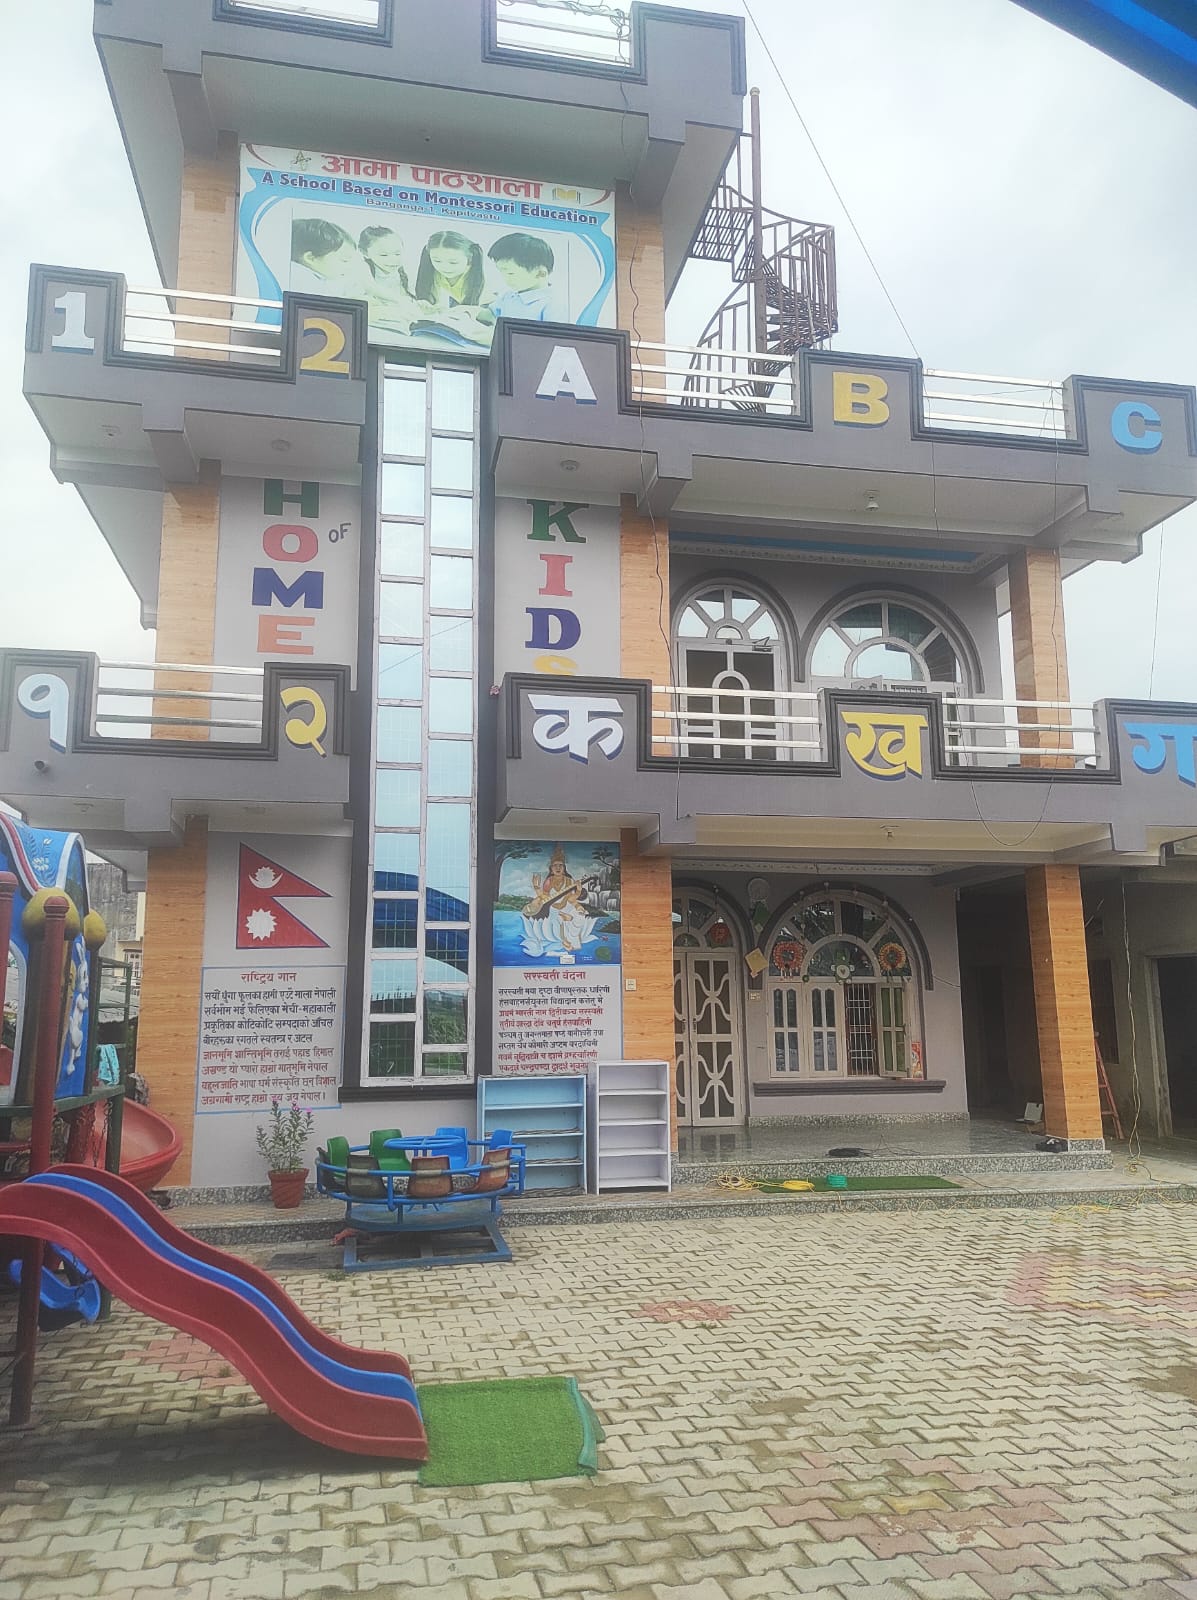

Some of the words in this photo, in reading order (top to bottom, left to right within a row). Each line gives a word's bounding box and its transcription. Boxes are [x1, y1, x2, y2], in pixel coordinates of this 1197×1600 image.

[321, 154, 400, 181] आमा
[411, 165, 543, 199] पाठशाला
[262, 171, 273, 185] A
[280, 173, 336, 191] School
[343, 181, 393, 198] Based
[399, 191, 419, 202] on
[425, 192, 515, 214] Montessori
[521, 203, 598, 225] Education
[441, 208, 500, 221] Kapilvastu
[52, 291, 94, 353] 1
[299, 317, 349, 376] 2
[536, 346, 597, 403] A
[833, 371, 889, 427] B
[1111, 401, 1162, 453] C
[329, 522, 351, 543] OF
[251, 479, 324, 655] HOME
[528, 694, 624, 763] क
[841, 711, 928, 781] ख
[241, 971, 274, 984] राष्ट्रिय
[278, 973, 297, 982] गान
[524, 969, 559, 981] सरस्वती
[562, 970, 586, 981] वंदना
[262, 989, 277, 1000] हामी
[294, 990, 312, 1000] माला
[314, 987, 336, 1000] नेपाली
[498, 986, 523, 996] सरस्वती
[597, 995, 604, 1005] मे
[233, 1002, 245, 1016] भई
[204, 1019, 235, 1033] प्रकृतिका
[275, 1016, 309, 1030] सम्पदाको
[236, 1032, 258, 1045] रगतले
[260, 1035, 286, 1045] स्वतन्त्र
[294, 1034, 312, 1044] अटल
[274, 1046, 290, 1059] तराई
[293, 1048, 311, 1059] पहाड
[313, 1046, 334, 1058] हिमाल
[202, 1066, 227, 1076] अखण्ड
[229, 1062, 238, 1074] यो
[240, 1061, 258, 1074] प्यारो
[260, 1061, 276, 1074] हाम्रो
[278, 1060, 306, 1075] मातृभूमि
[307, 1059, 328, 1072] नेपाल
[240, 1079, 256, 1089] भाषा
[258, 1076, 271, 1088] धर्म
[272, 1075, 300, 1090] संस्कृति
[302, 1077, 314, 1088] छन्
[316, 1075, 337, 1087] विशाल
[252, 1090, 267, 1104] हाम्रो
